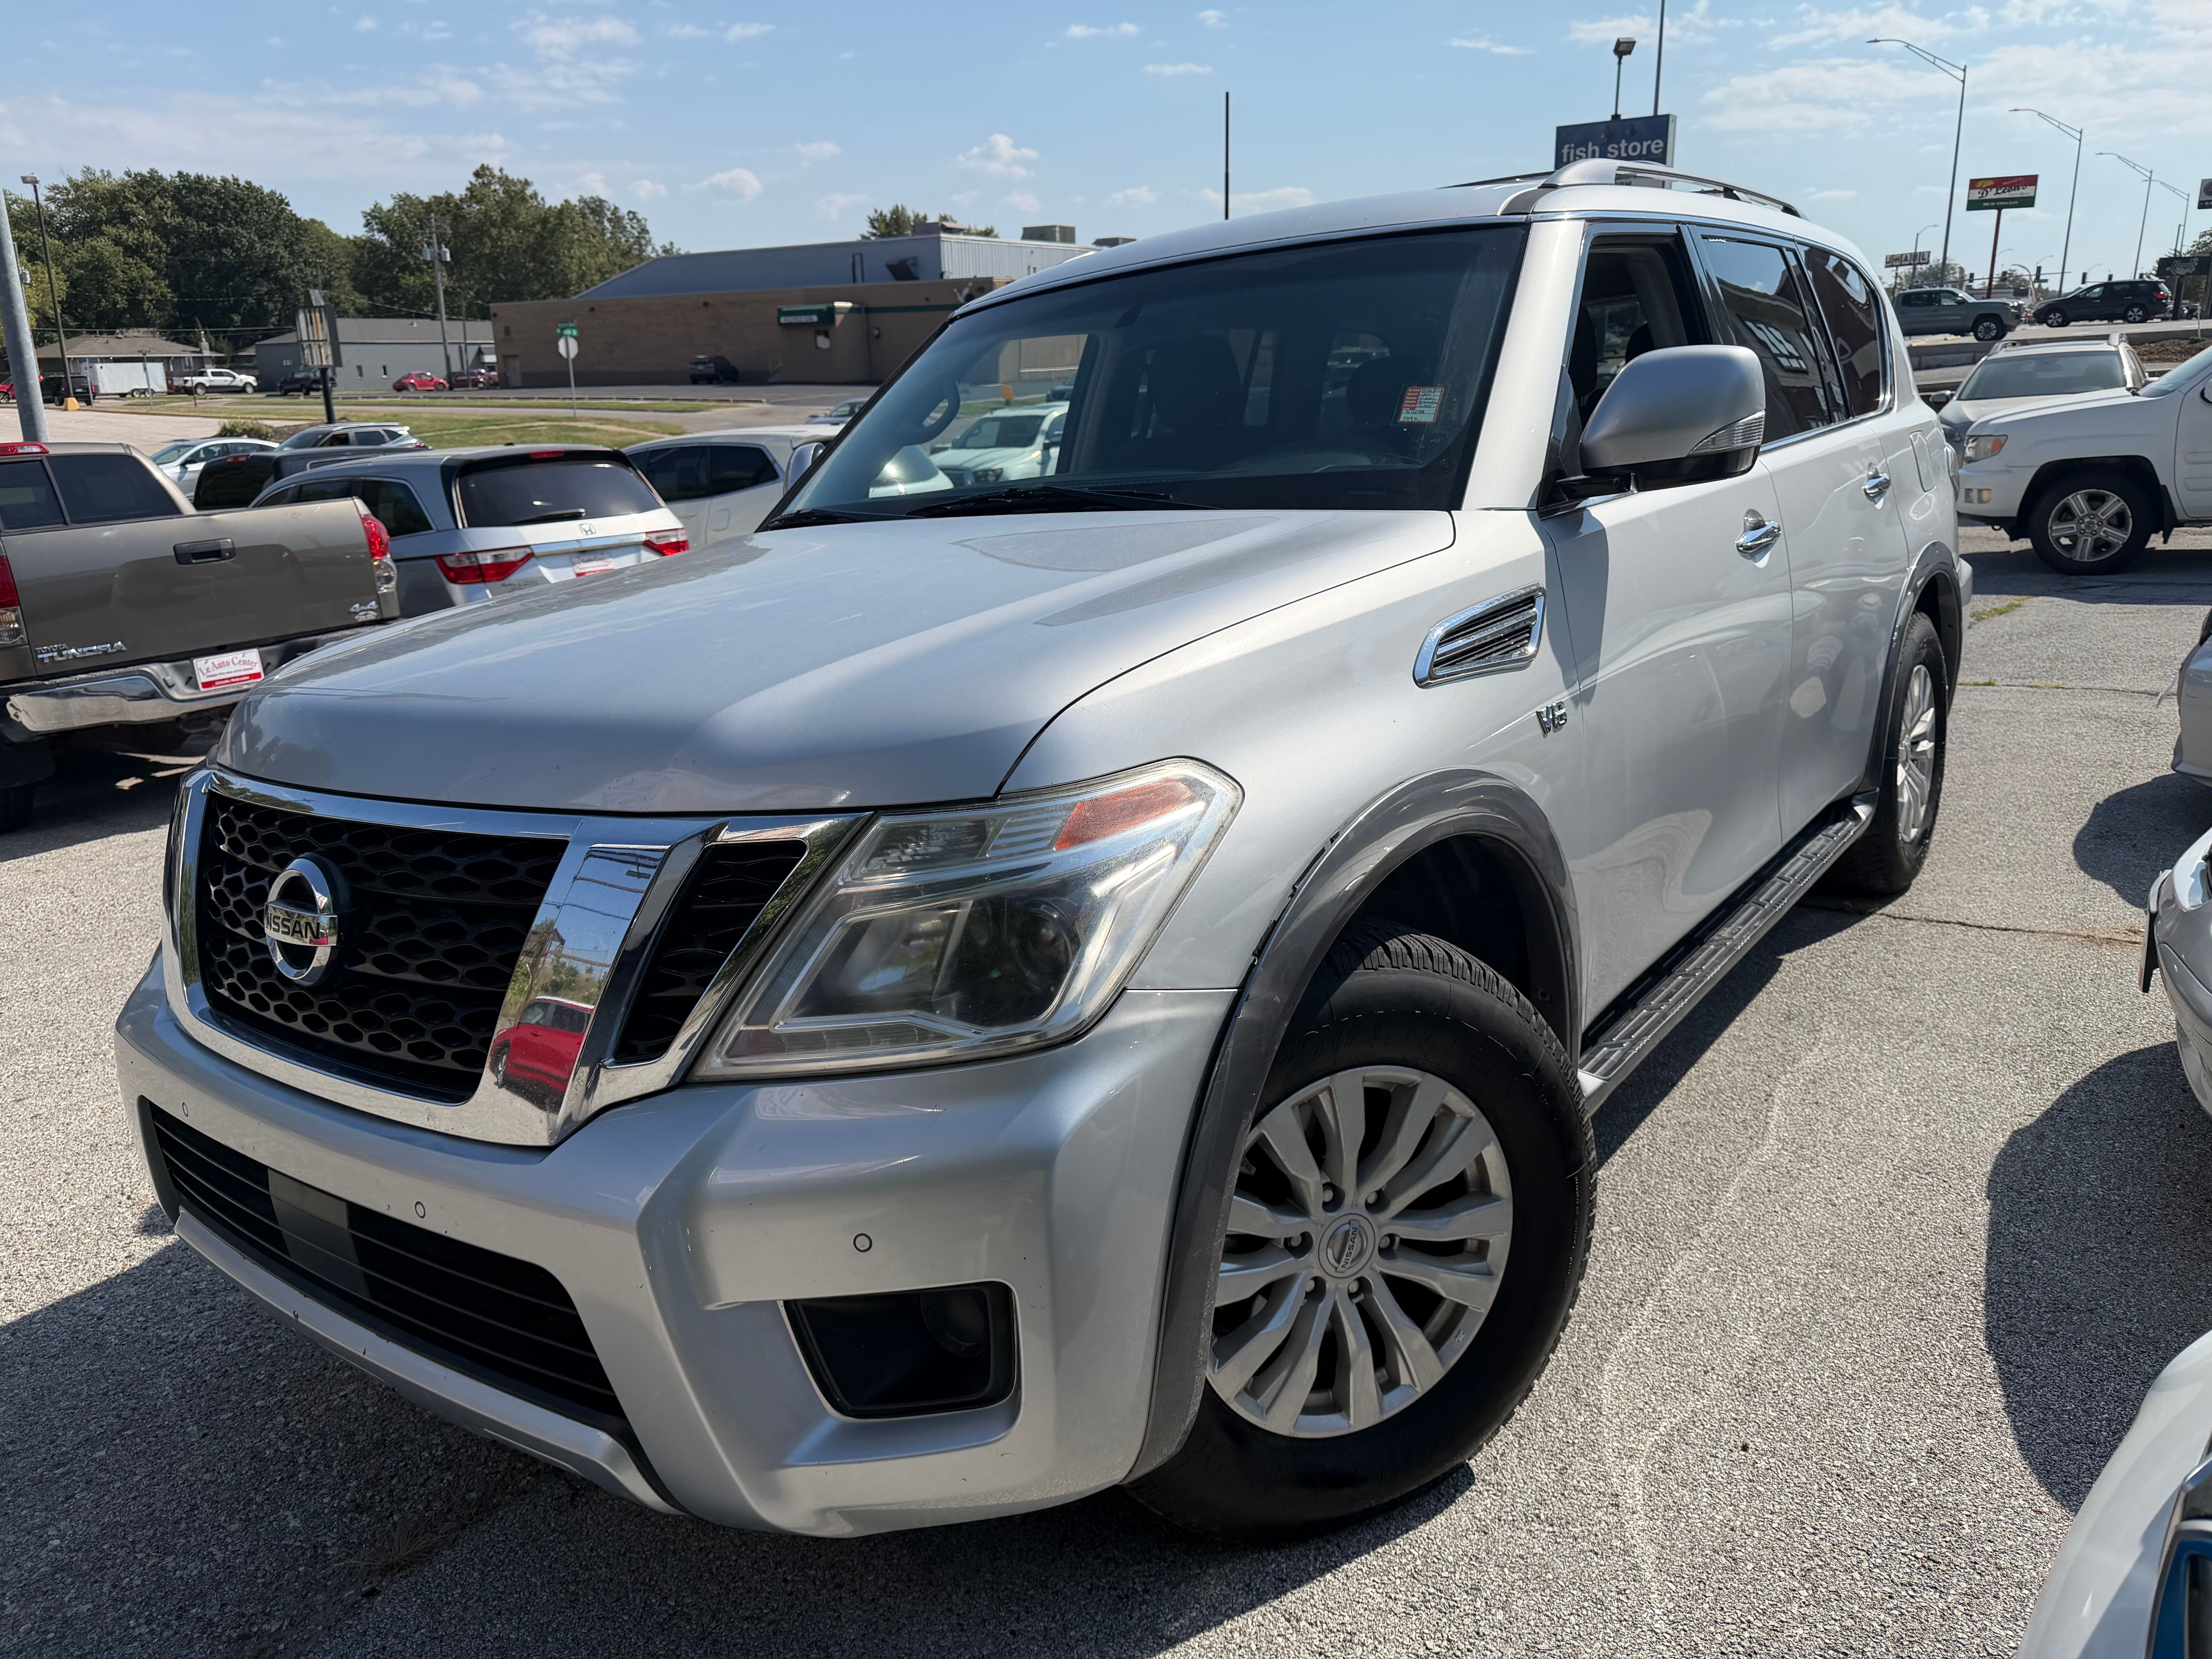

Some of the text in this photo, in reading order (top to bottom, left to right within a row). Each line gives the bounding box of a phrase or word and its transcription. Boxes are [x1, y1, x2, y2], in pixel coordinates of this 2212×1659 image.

[1561, 138, 1664, 163] fish store
[35, 643, 68, 653] TOYOTA
[37, 641, 127, 663] TUNDRA
[211, 660, 230, 670] Auto
[231, 657, 257, 666] Center
[1536, 701, 1568, 738] V8
[265, 912, 320, 939] NISSAN
[1341, 1227, 1359, 1269] NISSAN
